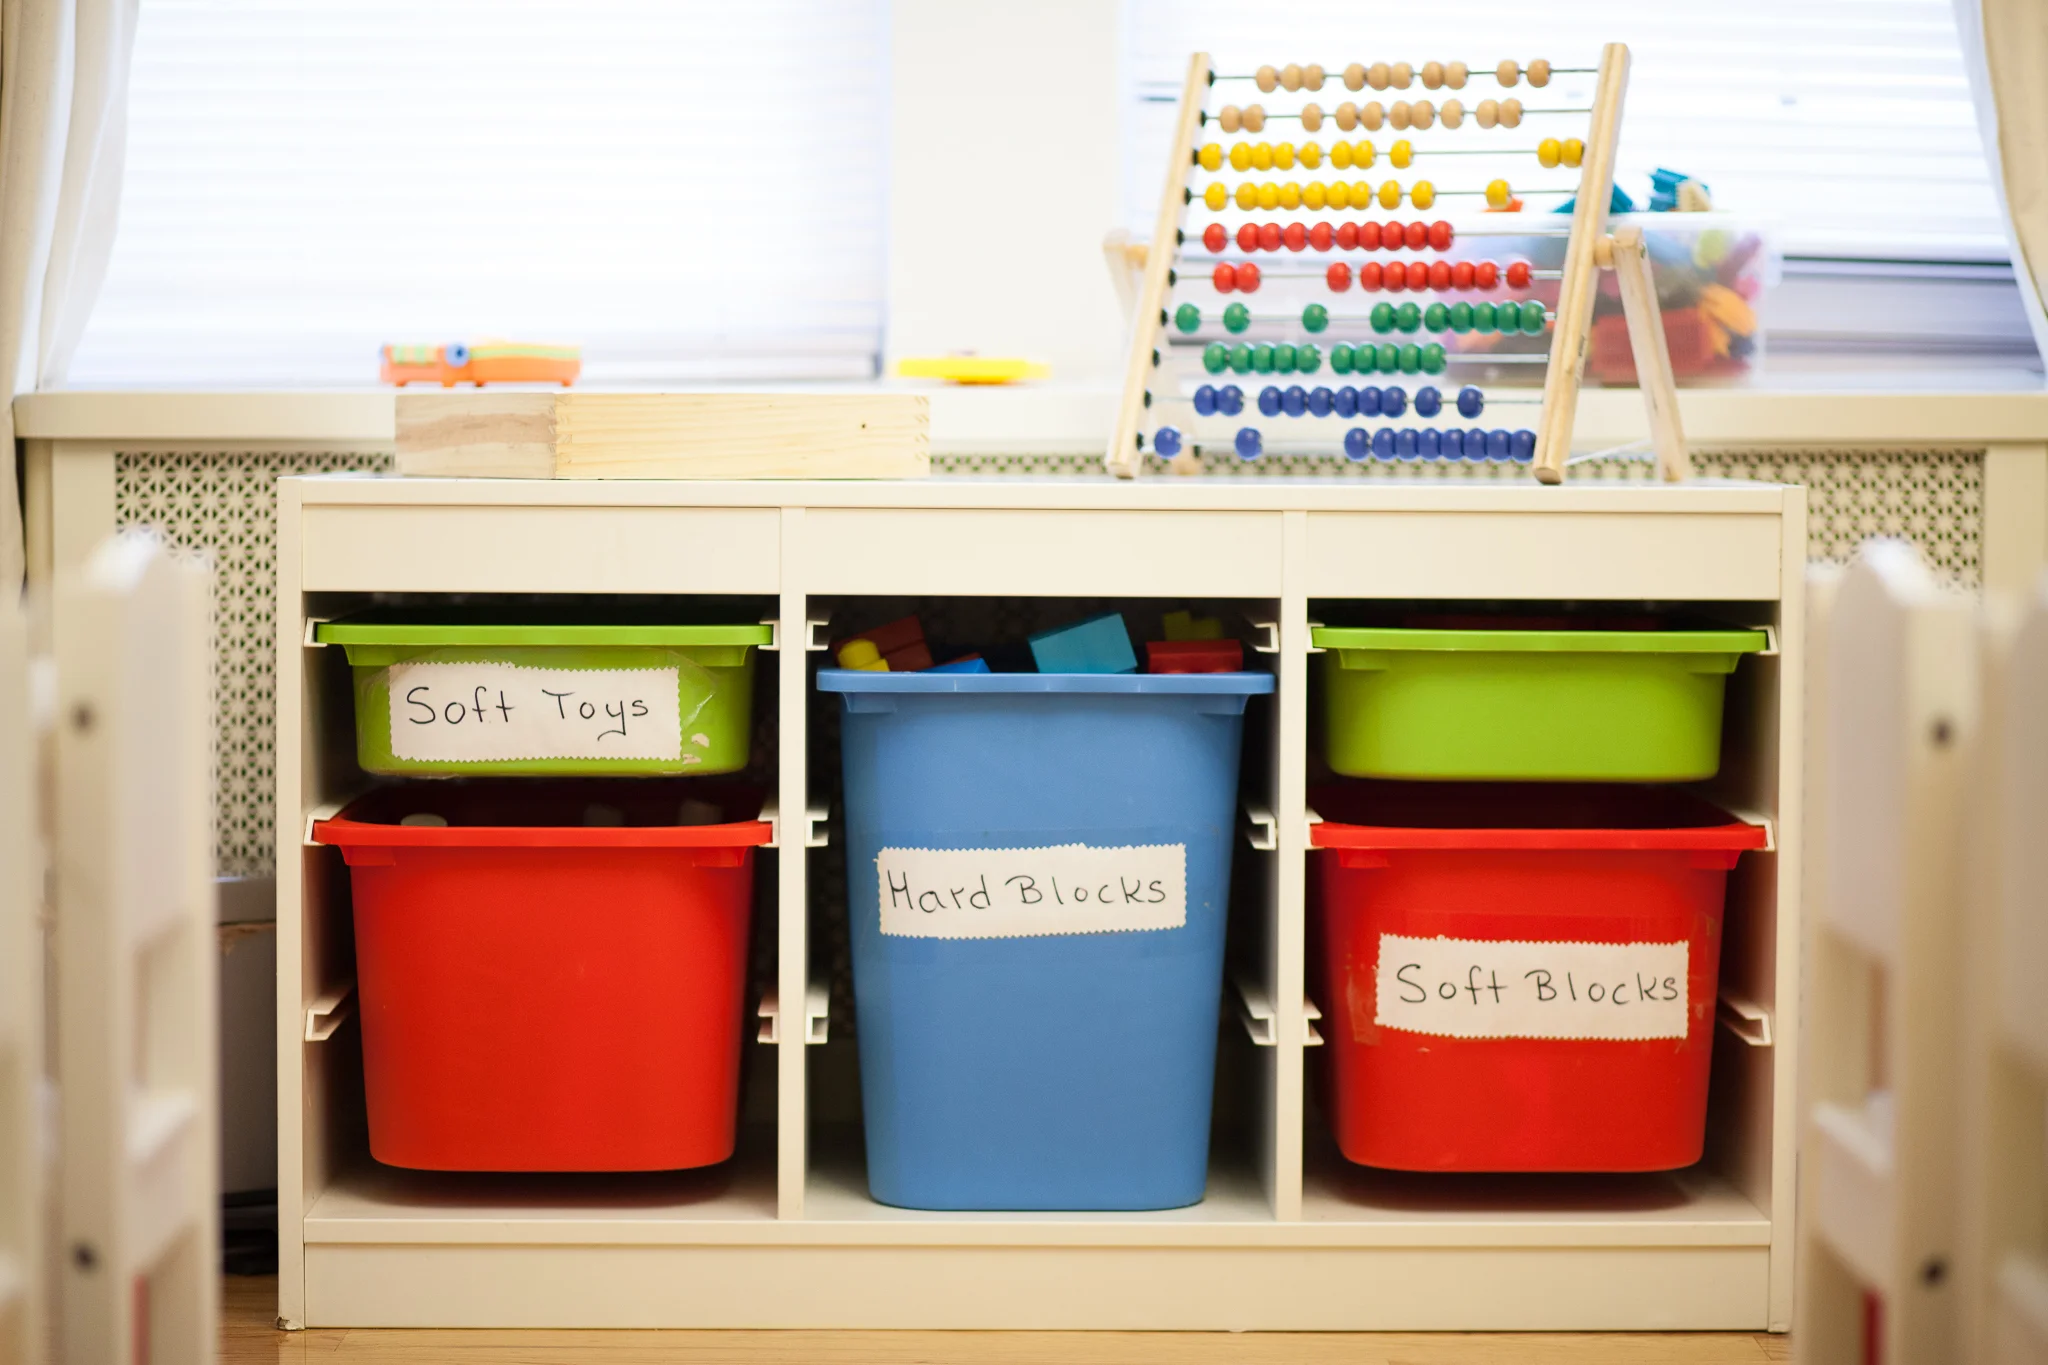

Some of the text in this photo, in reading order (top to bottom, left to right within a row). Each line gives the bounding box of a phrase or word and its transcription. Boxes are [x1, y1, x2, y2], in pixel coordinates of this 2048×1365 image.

[406, 685, 649, 741] Soft Toys
[887, 870, 1167, 914] Hard Blocks
[1396, 963, 1679, 1006] Soft Blocks
